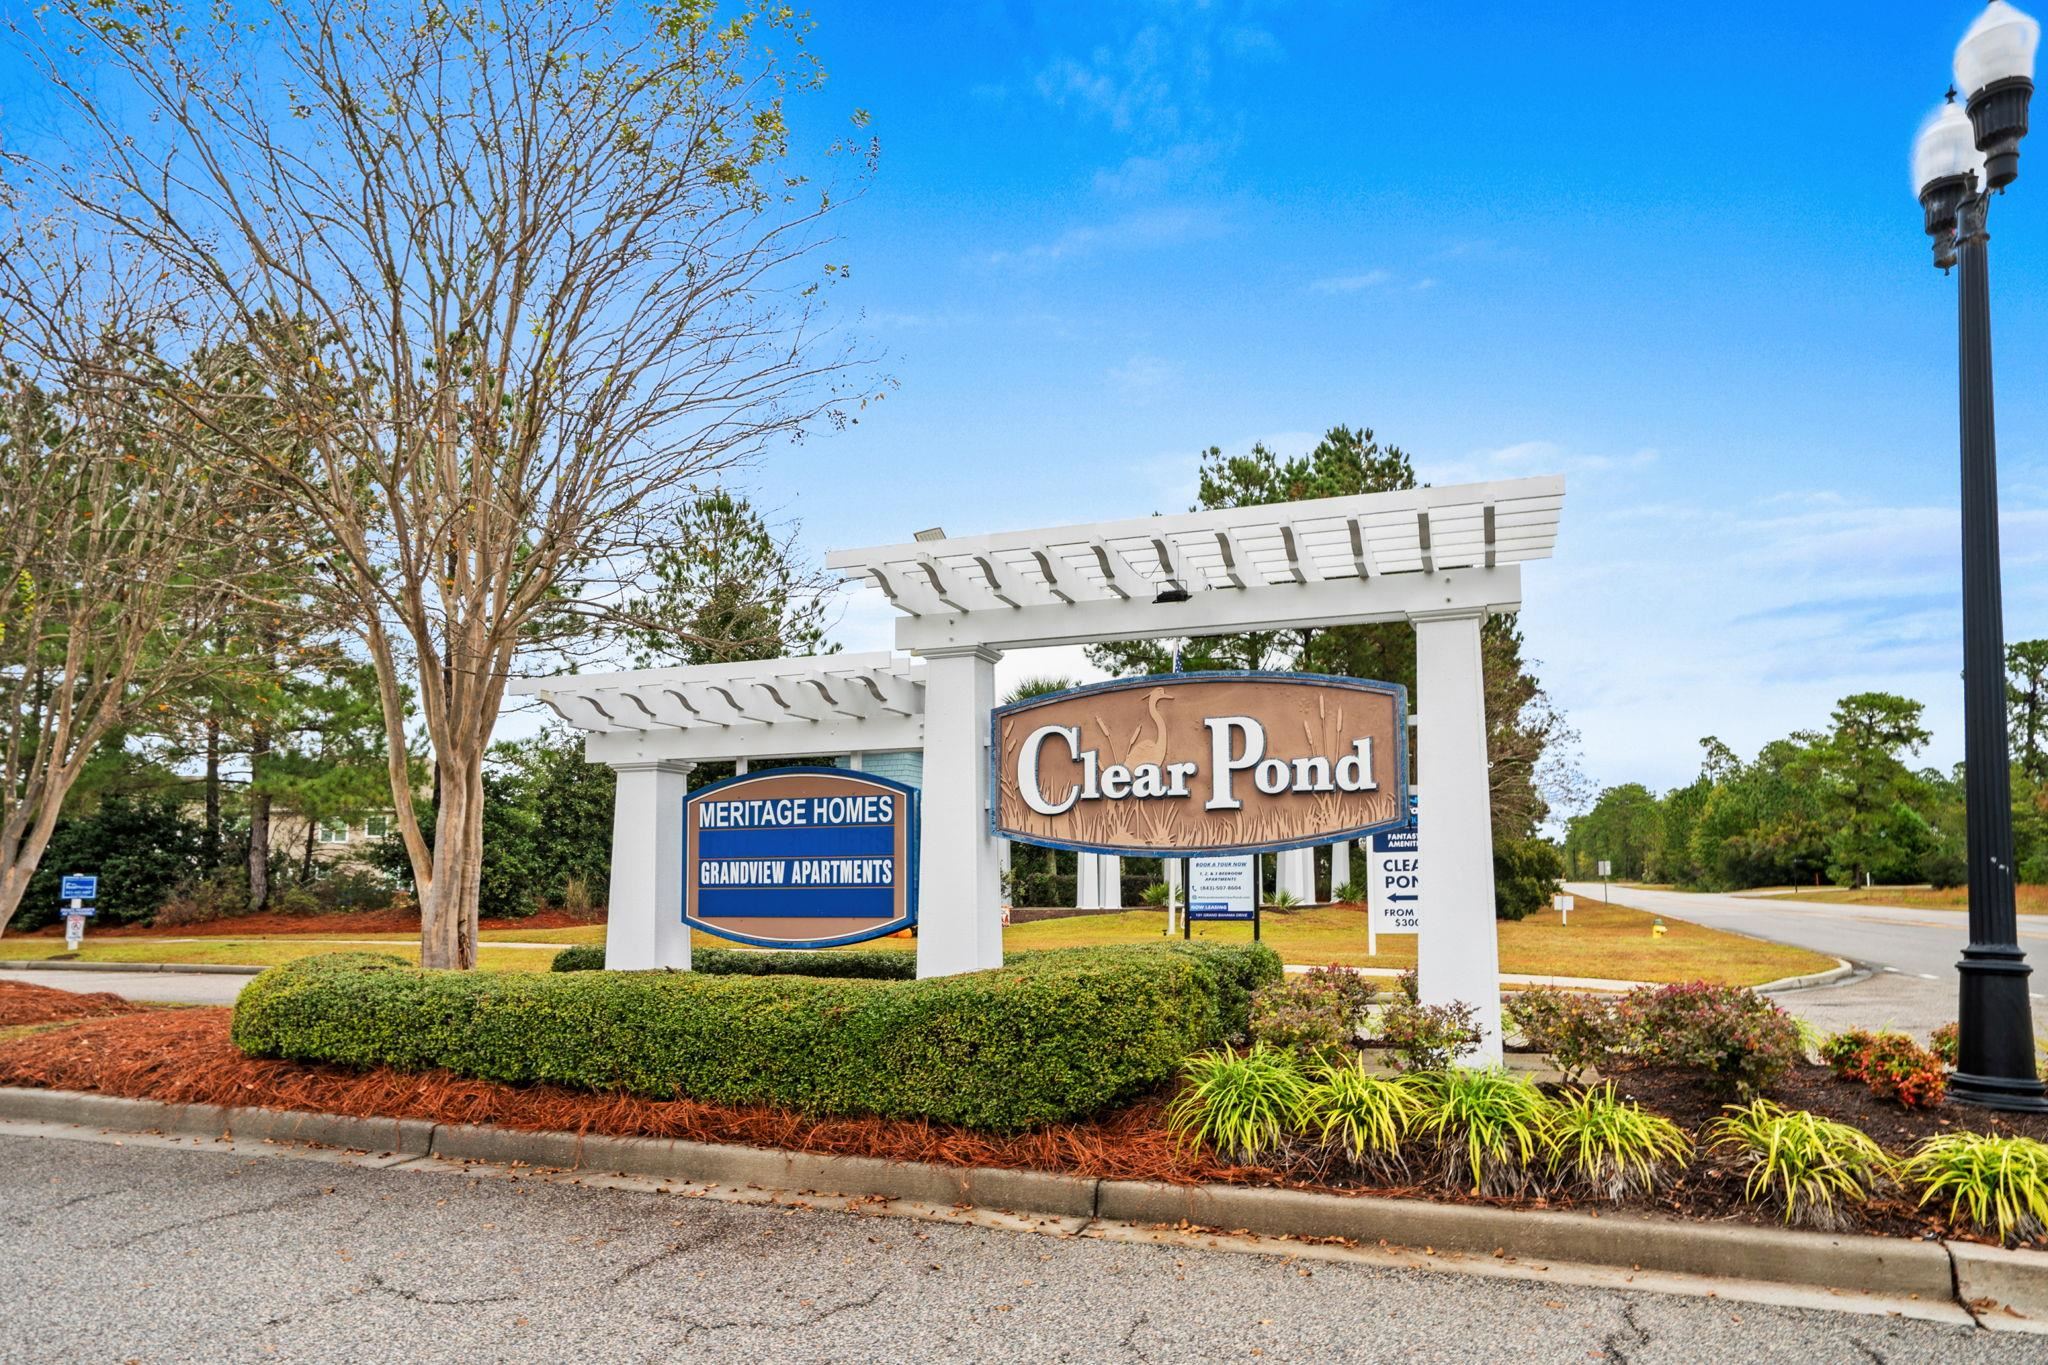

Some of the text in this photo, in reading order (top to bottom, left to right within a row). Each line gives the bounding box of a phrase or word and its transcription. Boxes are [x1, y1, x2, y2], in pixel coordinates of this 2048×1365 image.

[1017, 715, 1378, 815] Clear Pond
[699, 796, 893, 828] MERITAGE HOMES
[701, 859, 893, 885] GRANDVIEW APARTMENTS
[1383, 858, 1418, 872] CLEA
[1385, 875, 1418, 889] PON
[1384, 908, 1415, 917] FROM
[1395, 918, 1418, 927] $300
